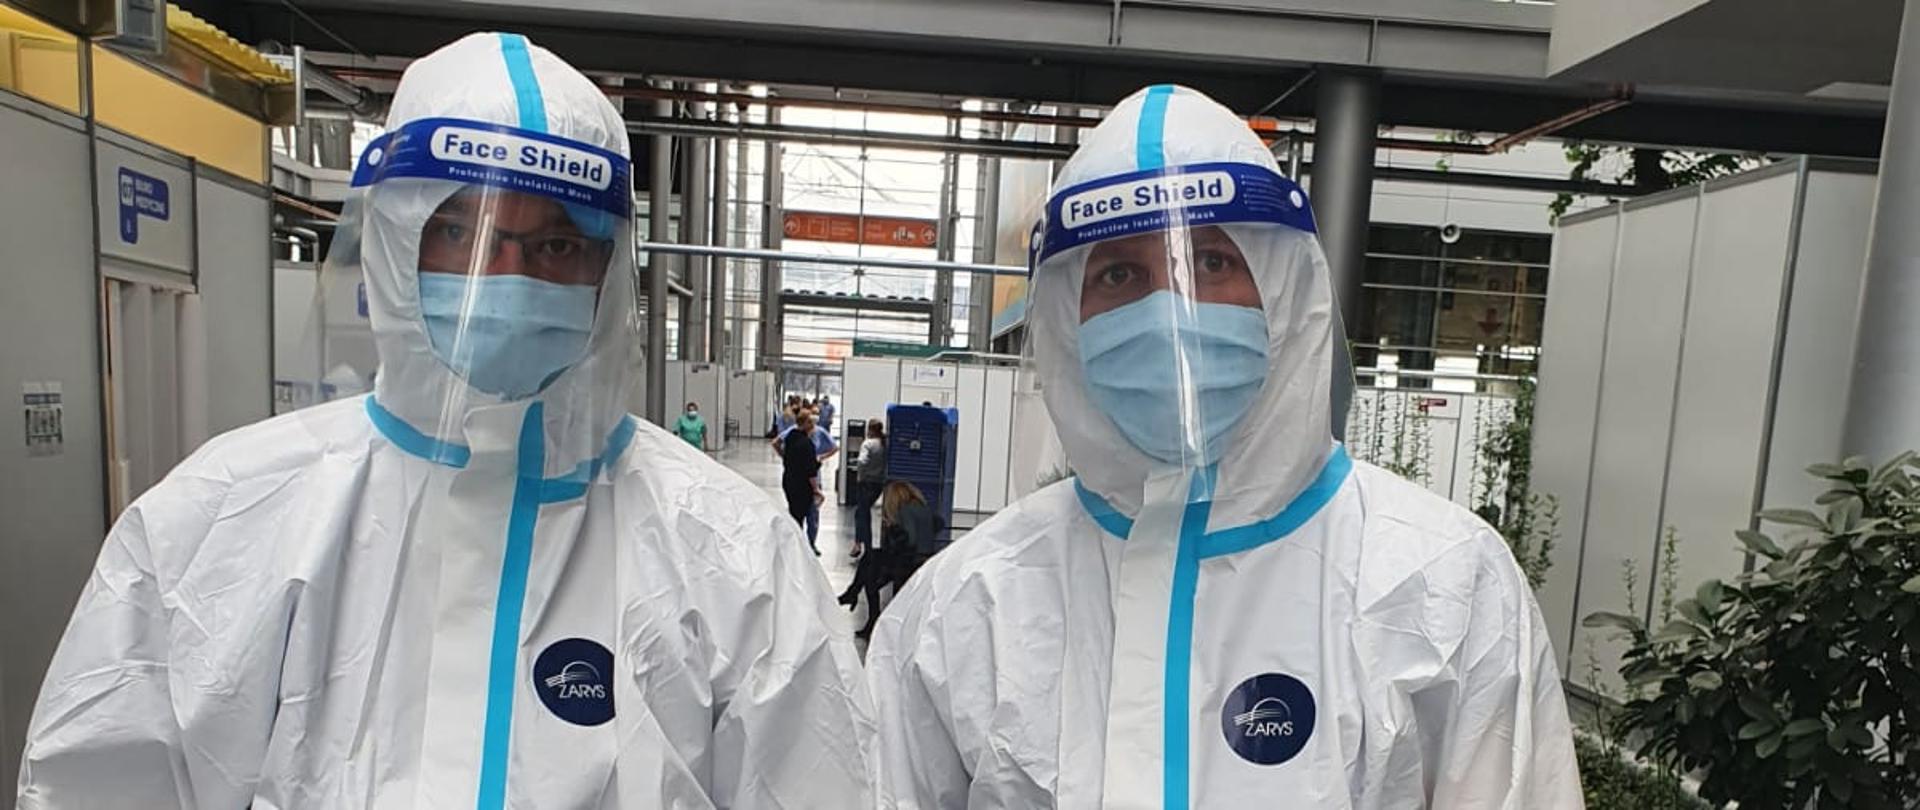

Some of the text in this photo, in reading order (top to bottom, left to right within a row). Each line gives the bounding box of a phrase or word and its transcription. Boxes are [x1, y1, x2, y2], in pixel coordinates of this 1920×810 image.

[444, 133, 508, 161] Face
[519, 145, 603, 183] Shield
[1069, 195, 1123, 222] Face
[1133, 178, 1223, 207] Shield
[559, 684, 606, 699] ZARYS
[1244, 720, 1294, 737] ZARYS
